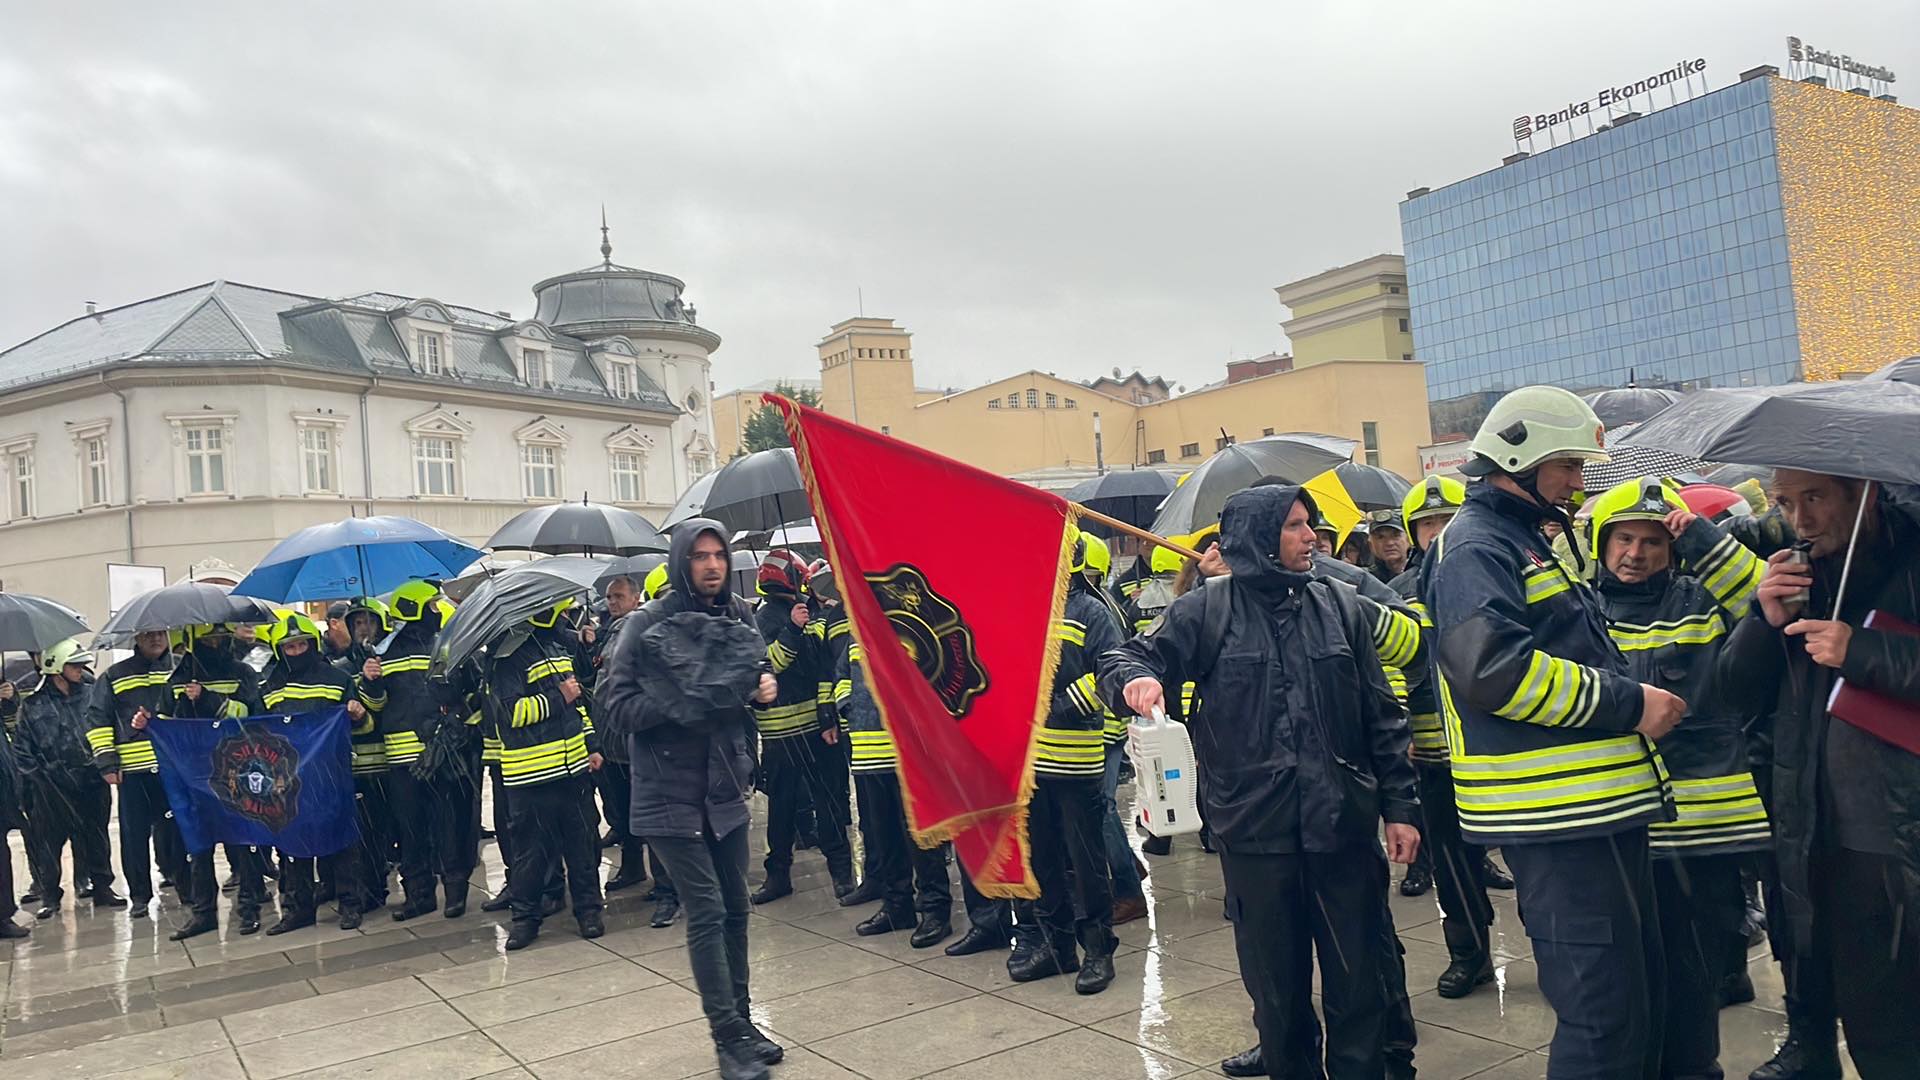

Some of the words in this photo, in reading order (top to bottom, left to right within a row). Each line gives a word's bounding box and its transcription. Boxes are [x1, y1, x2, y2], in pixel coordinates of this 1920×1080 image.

[1806, 45, 1840, 68] Banka
[1841, 55, 1896, 82] Ekonomike
[1535, 103, 1589, 130] Banka
[1598, 58, 1706, 107] Ekonomike
